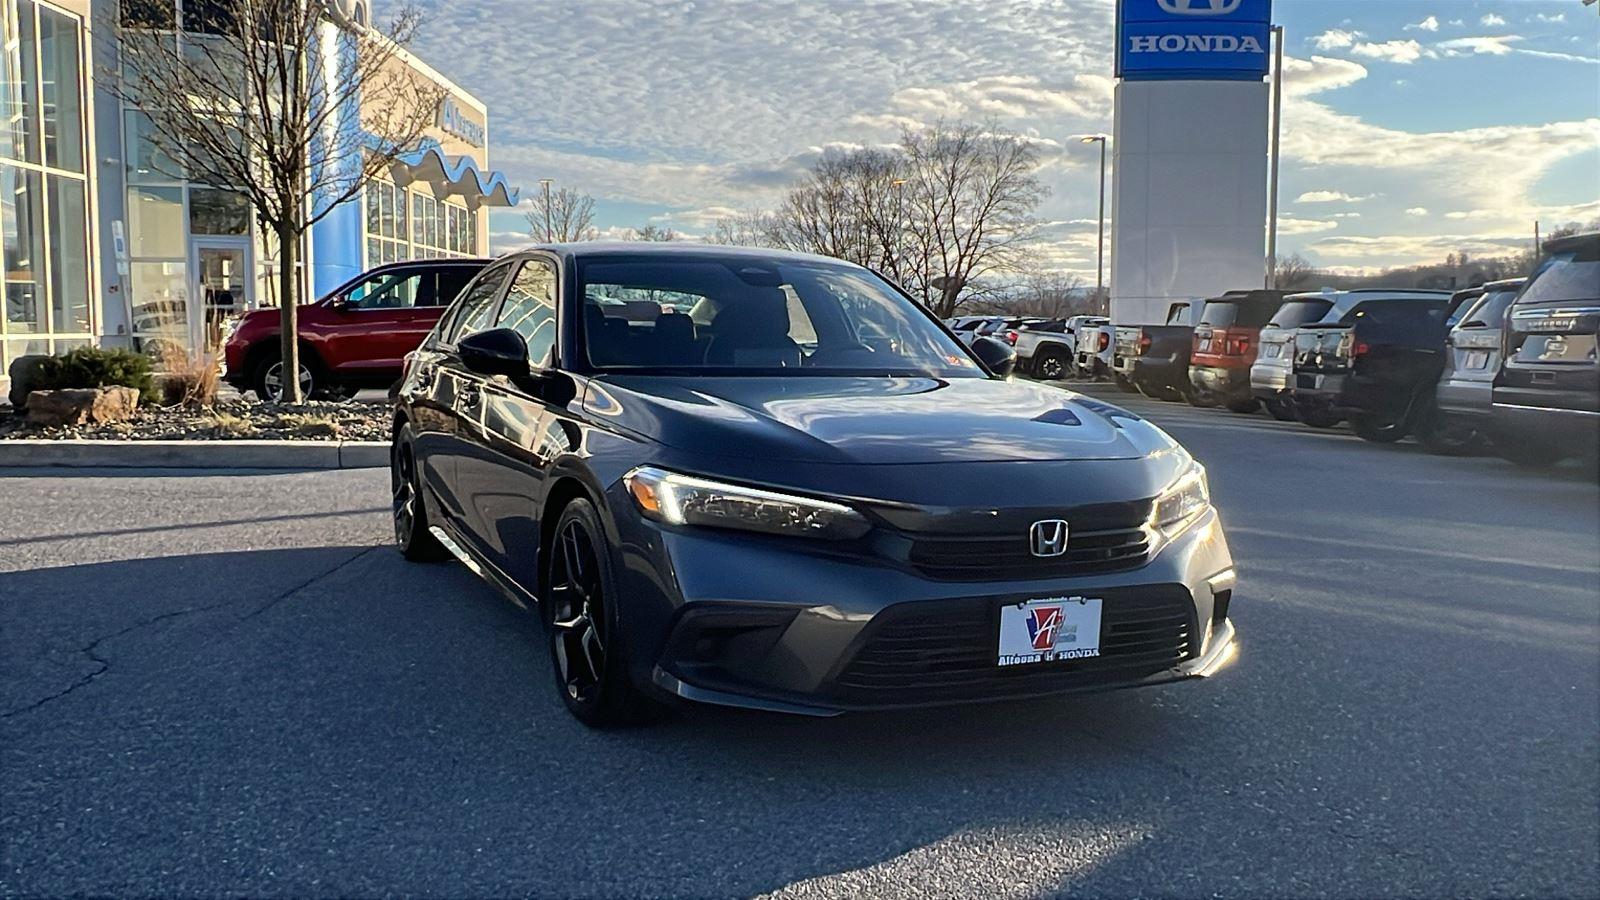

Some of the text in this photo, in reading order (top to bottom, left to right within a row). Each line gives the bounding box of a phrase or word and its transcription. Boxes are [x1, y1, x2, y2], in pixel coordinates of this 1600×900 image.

[1129, 35, 1264, 53] HONDA
[998, 654, 1041, 666] Altoona
[1059, 648, 1100, 660] HONDA
